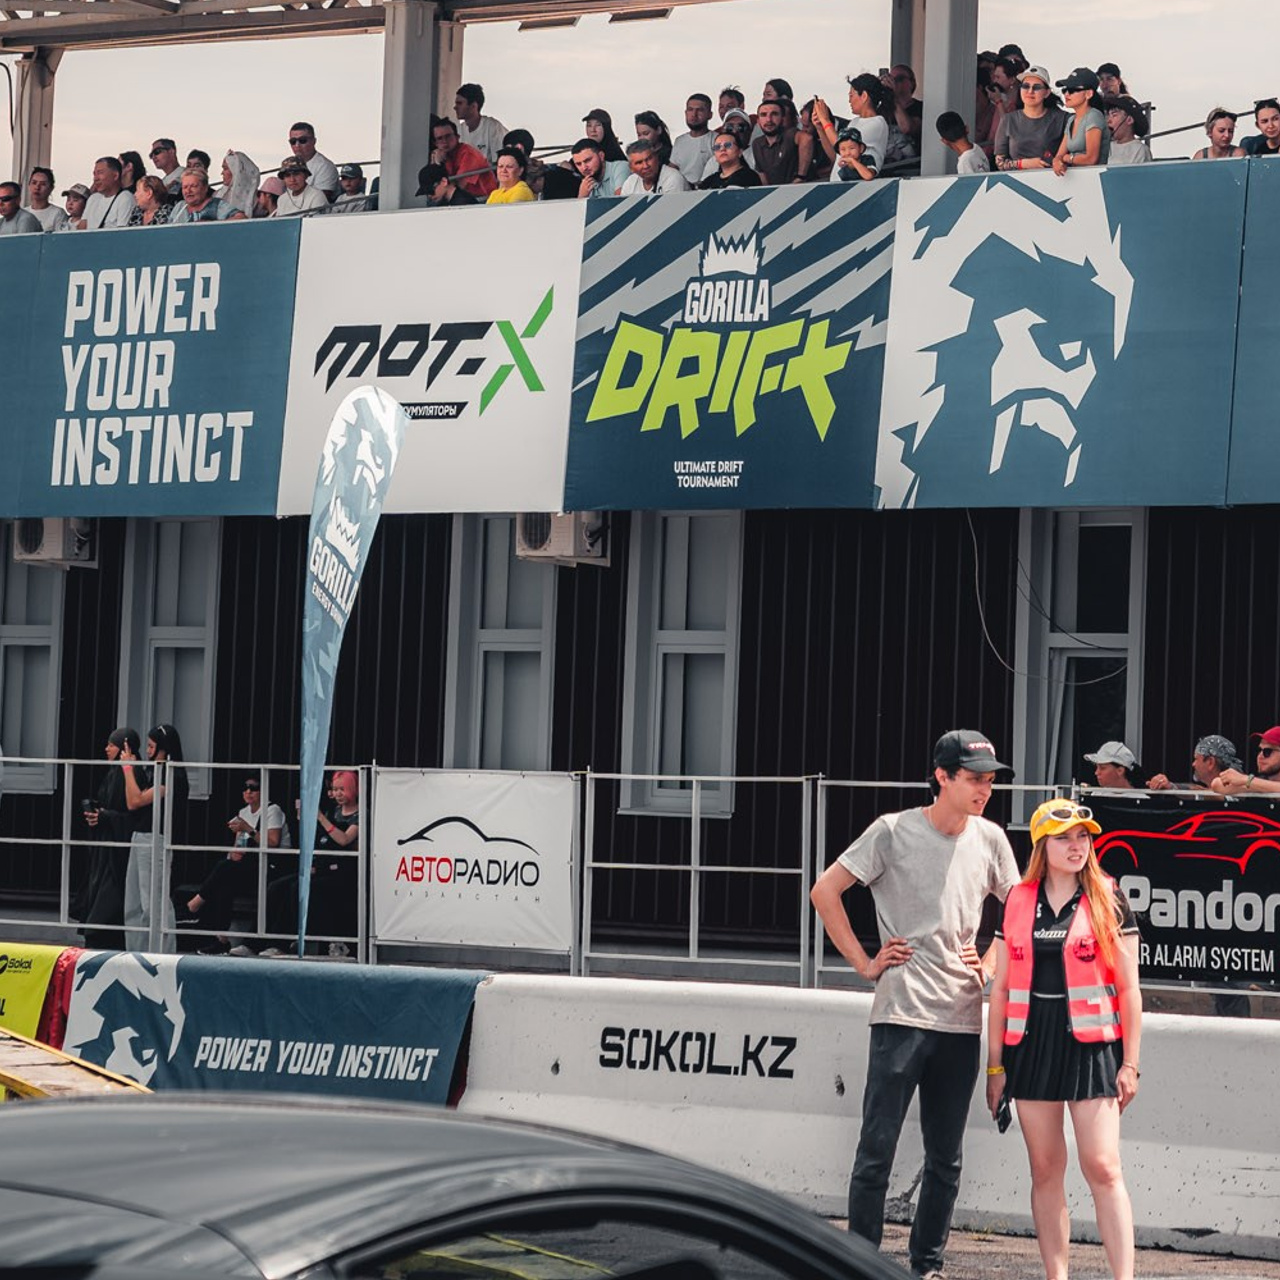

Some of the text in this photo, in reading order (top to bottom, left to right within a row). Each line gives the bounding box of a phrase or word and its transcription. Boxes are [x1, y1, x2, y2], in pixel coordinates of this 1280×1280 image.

[65, 262, 220, 338] POWER
[684, 279, 769, 323] GORILLA
[61, 340, 176, 412] YOUR
[586, 318, 853, 442] DRIFT
[405, 404, 457, 417] УМУЛЯТОРЫ
[50, 411, 254, 487] INSTINCT
[674, 460, 744, 473] ULTIMATE DRIFT
[677, 475, 740, 488] TOURNAMENT
[310, 536, 360, 614] GORILLA
[1154, 944, 1206, 969] ALARM
[1210, 947, 1274, 973] SYSTEM
[194, 1036, 440, 1081] POWER YOUR INSTINCT
[599, 1027, 797, 1079] SOKOL.KZ
